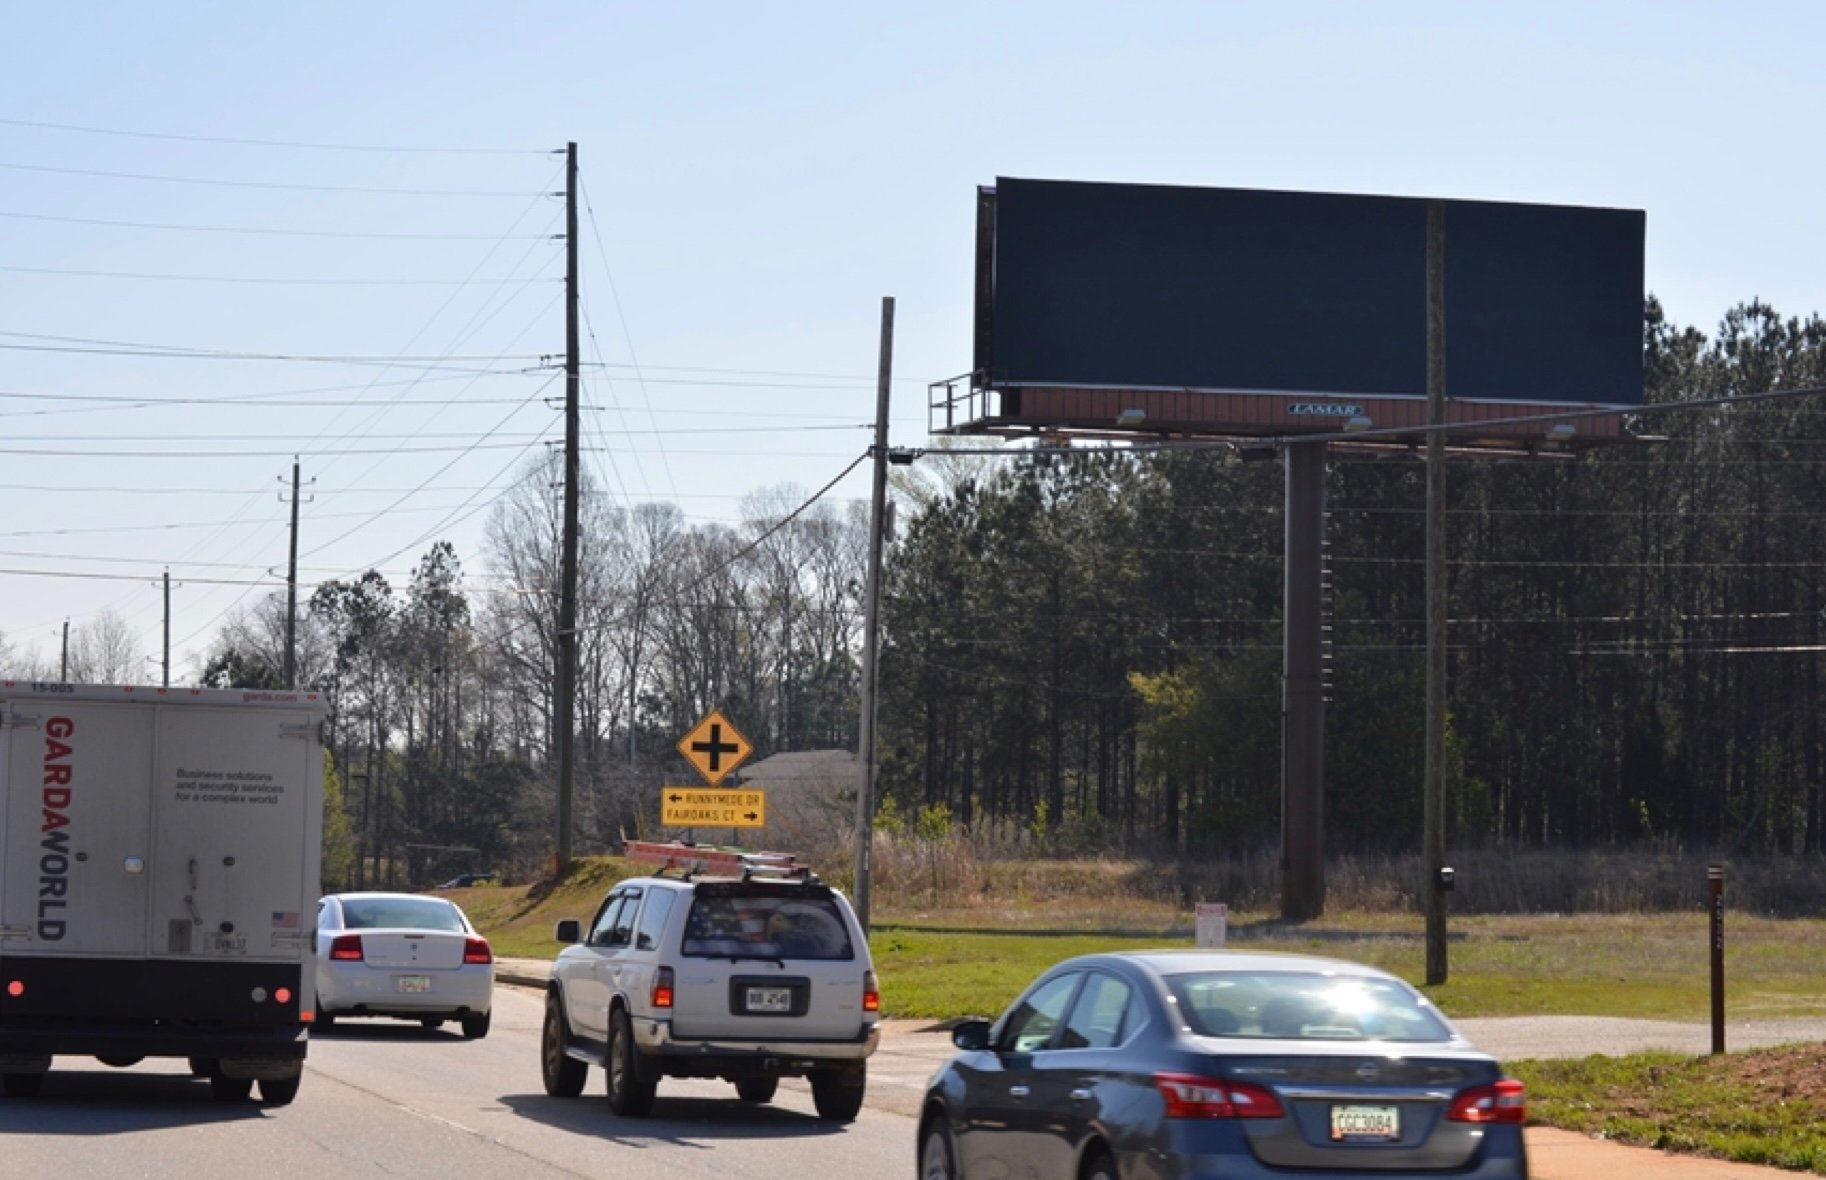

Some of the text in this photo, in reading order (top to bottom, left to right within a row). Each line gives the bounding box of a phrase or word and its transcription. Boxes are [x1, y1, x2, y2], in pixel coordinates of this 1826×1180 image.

[176, 768, 273, 781] Business solutions
[176, 781, 284, 794] and security services
[175, 792, 191, 801] for
[202, 794, 246, 804] complex
[248, 796, 278, 805] world
[38, 716, 74, 941] GARDAWORLD
